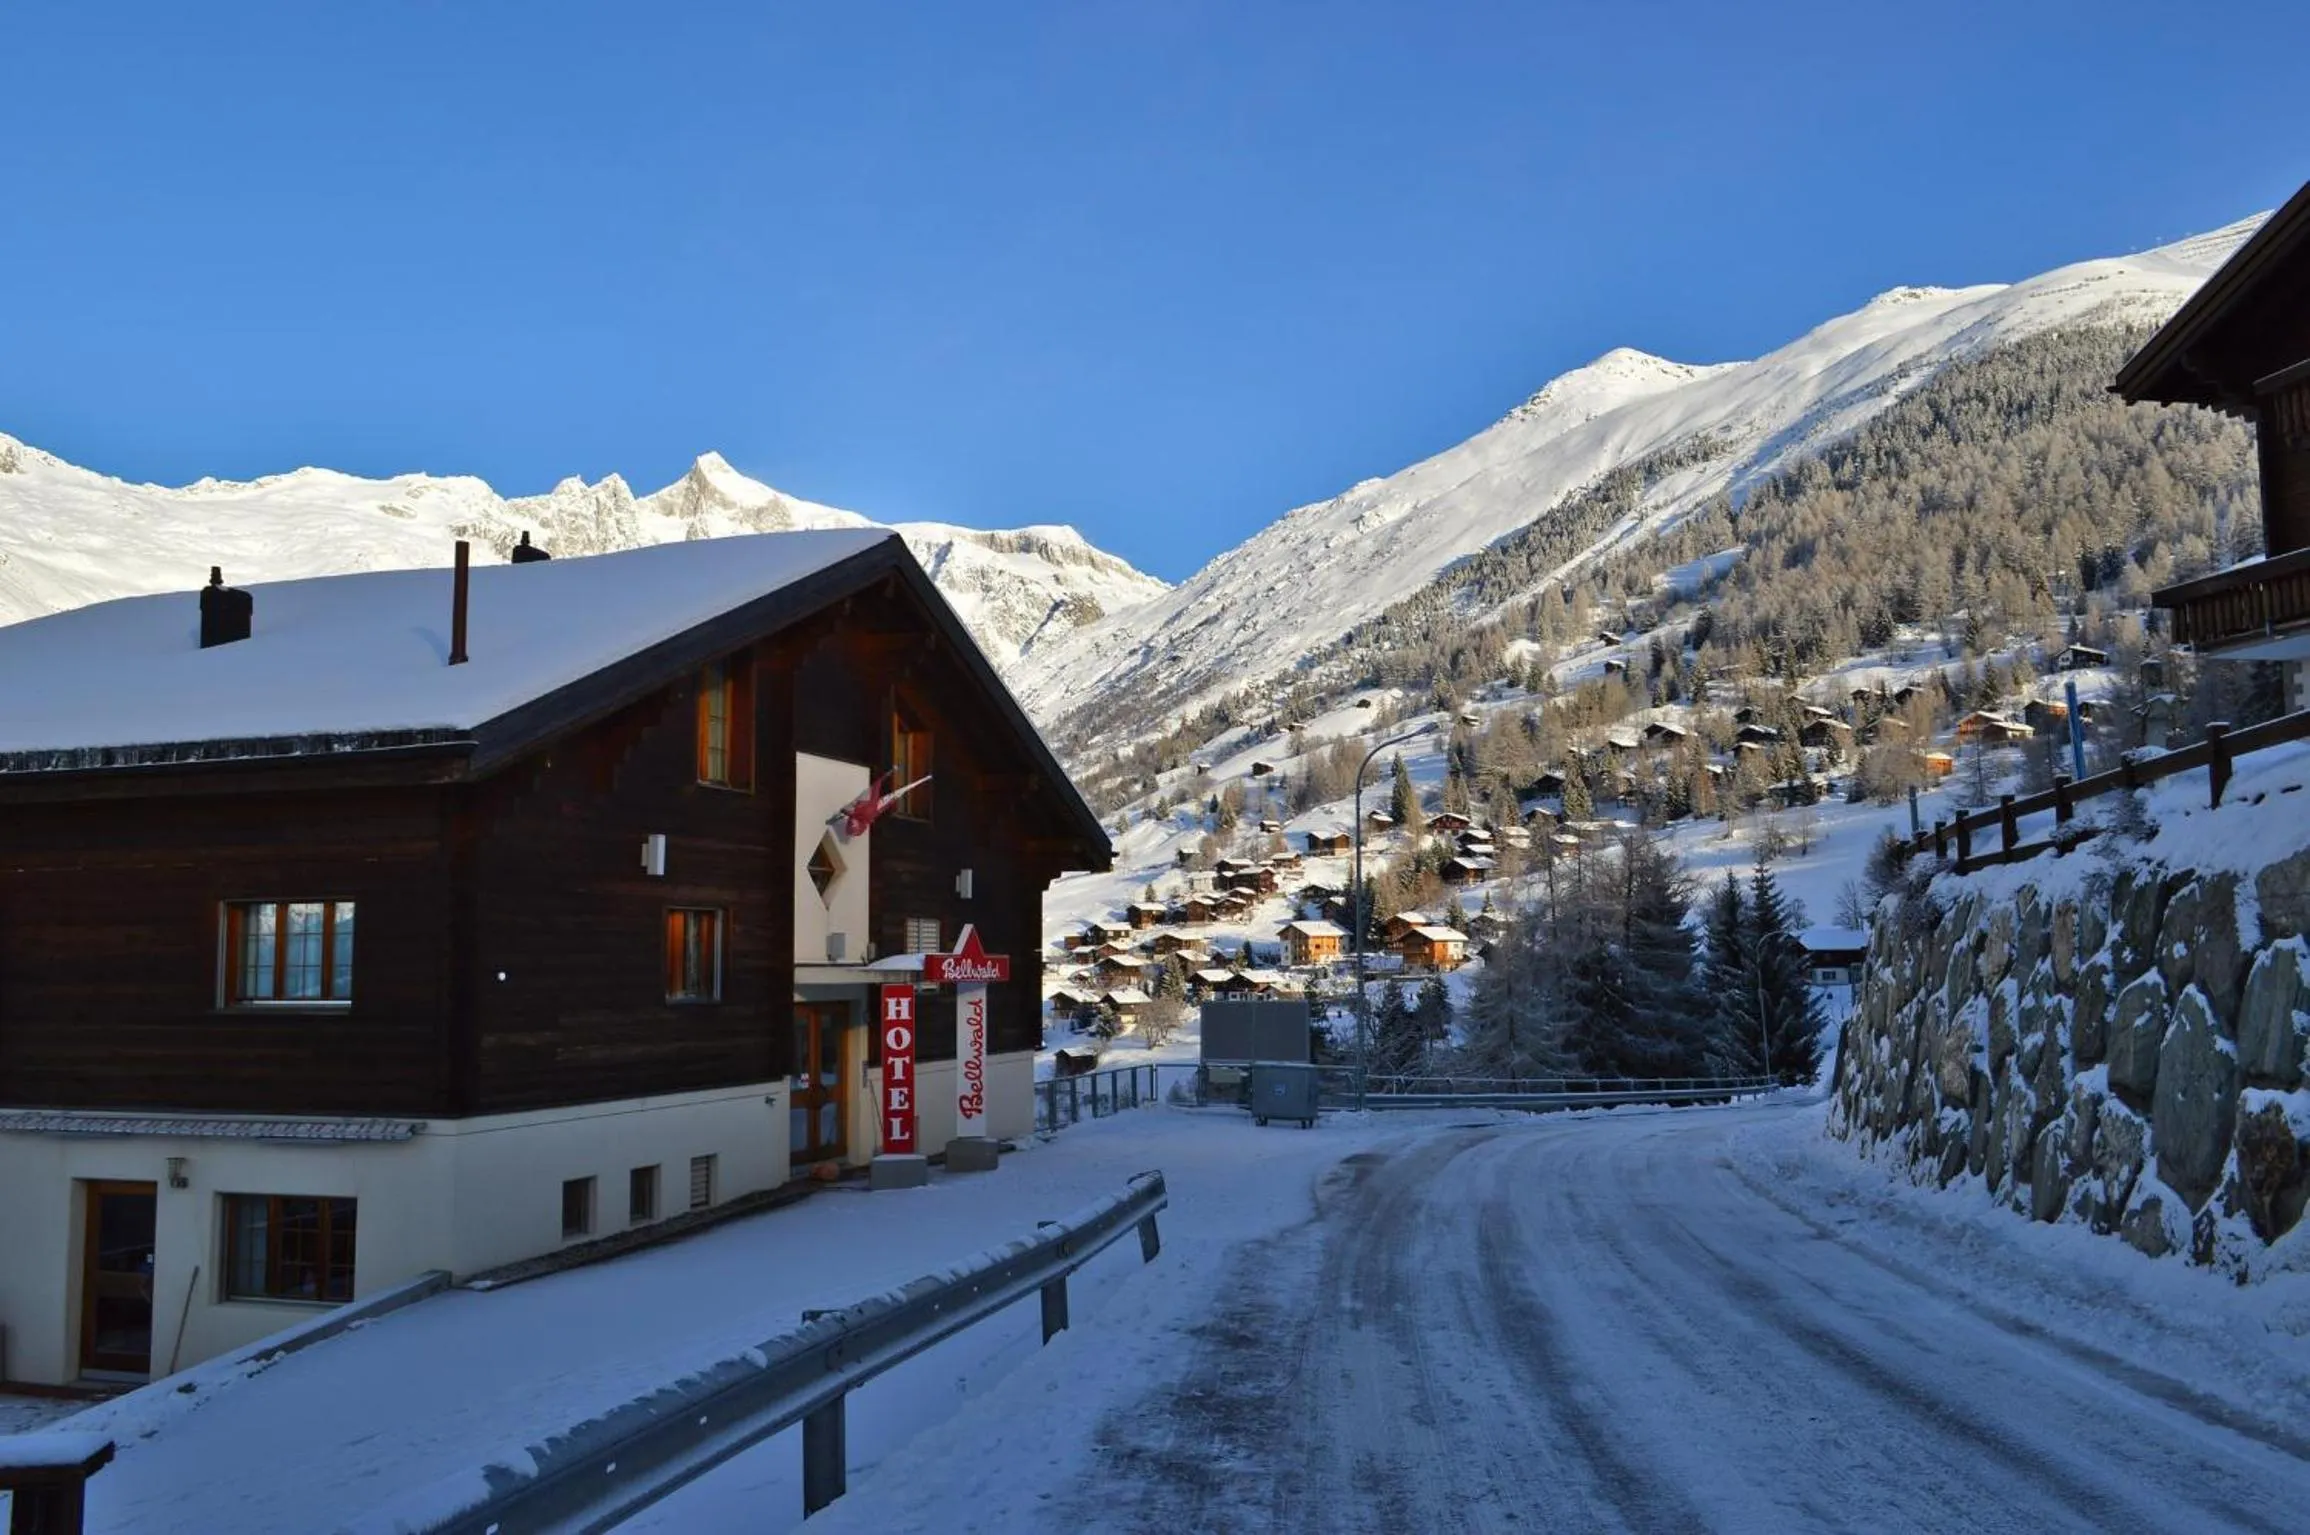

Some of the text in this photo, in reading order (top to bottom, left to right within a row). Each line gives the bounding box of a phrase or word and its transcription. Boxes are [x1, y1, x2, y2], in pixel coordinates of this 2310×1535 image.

[942, 958, 1000, 979] Bellwald
[886, 997, 911, 1140] HOTEL
[959, 999, 983, 1119] Bellwald
